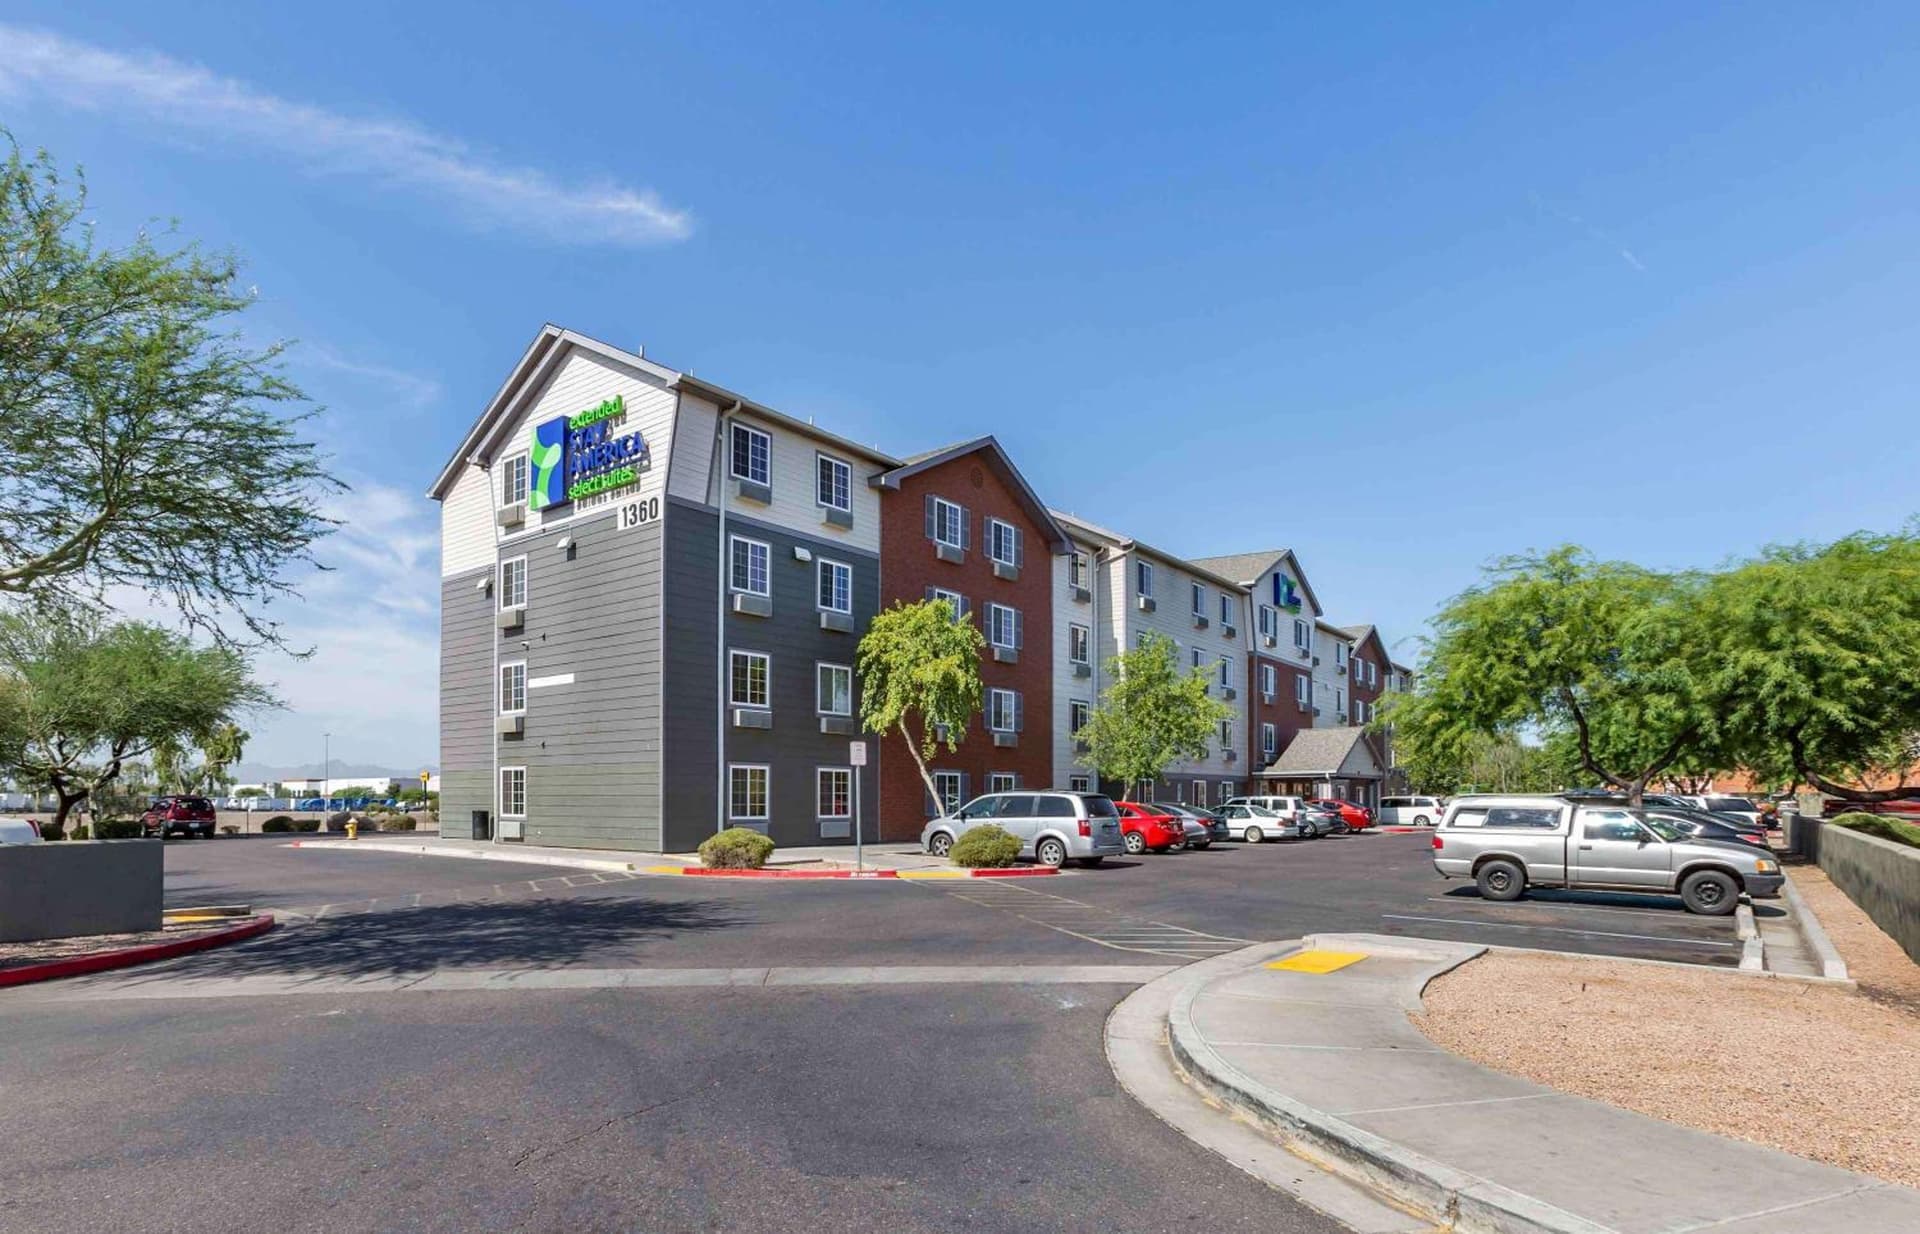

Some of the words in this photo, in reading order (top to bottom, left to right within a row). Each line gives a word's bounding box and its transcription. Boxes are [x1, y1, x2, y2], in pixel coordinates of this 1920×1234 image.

[569, 394, 623, 430] extended
[569, 420, 608, 452] STAY
[570, 431, 644, 474] AMERICA
[568, 473, 601, 500] select
[602, 466, 637, 490] suites
[622, 497, 659, 527] 1360
